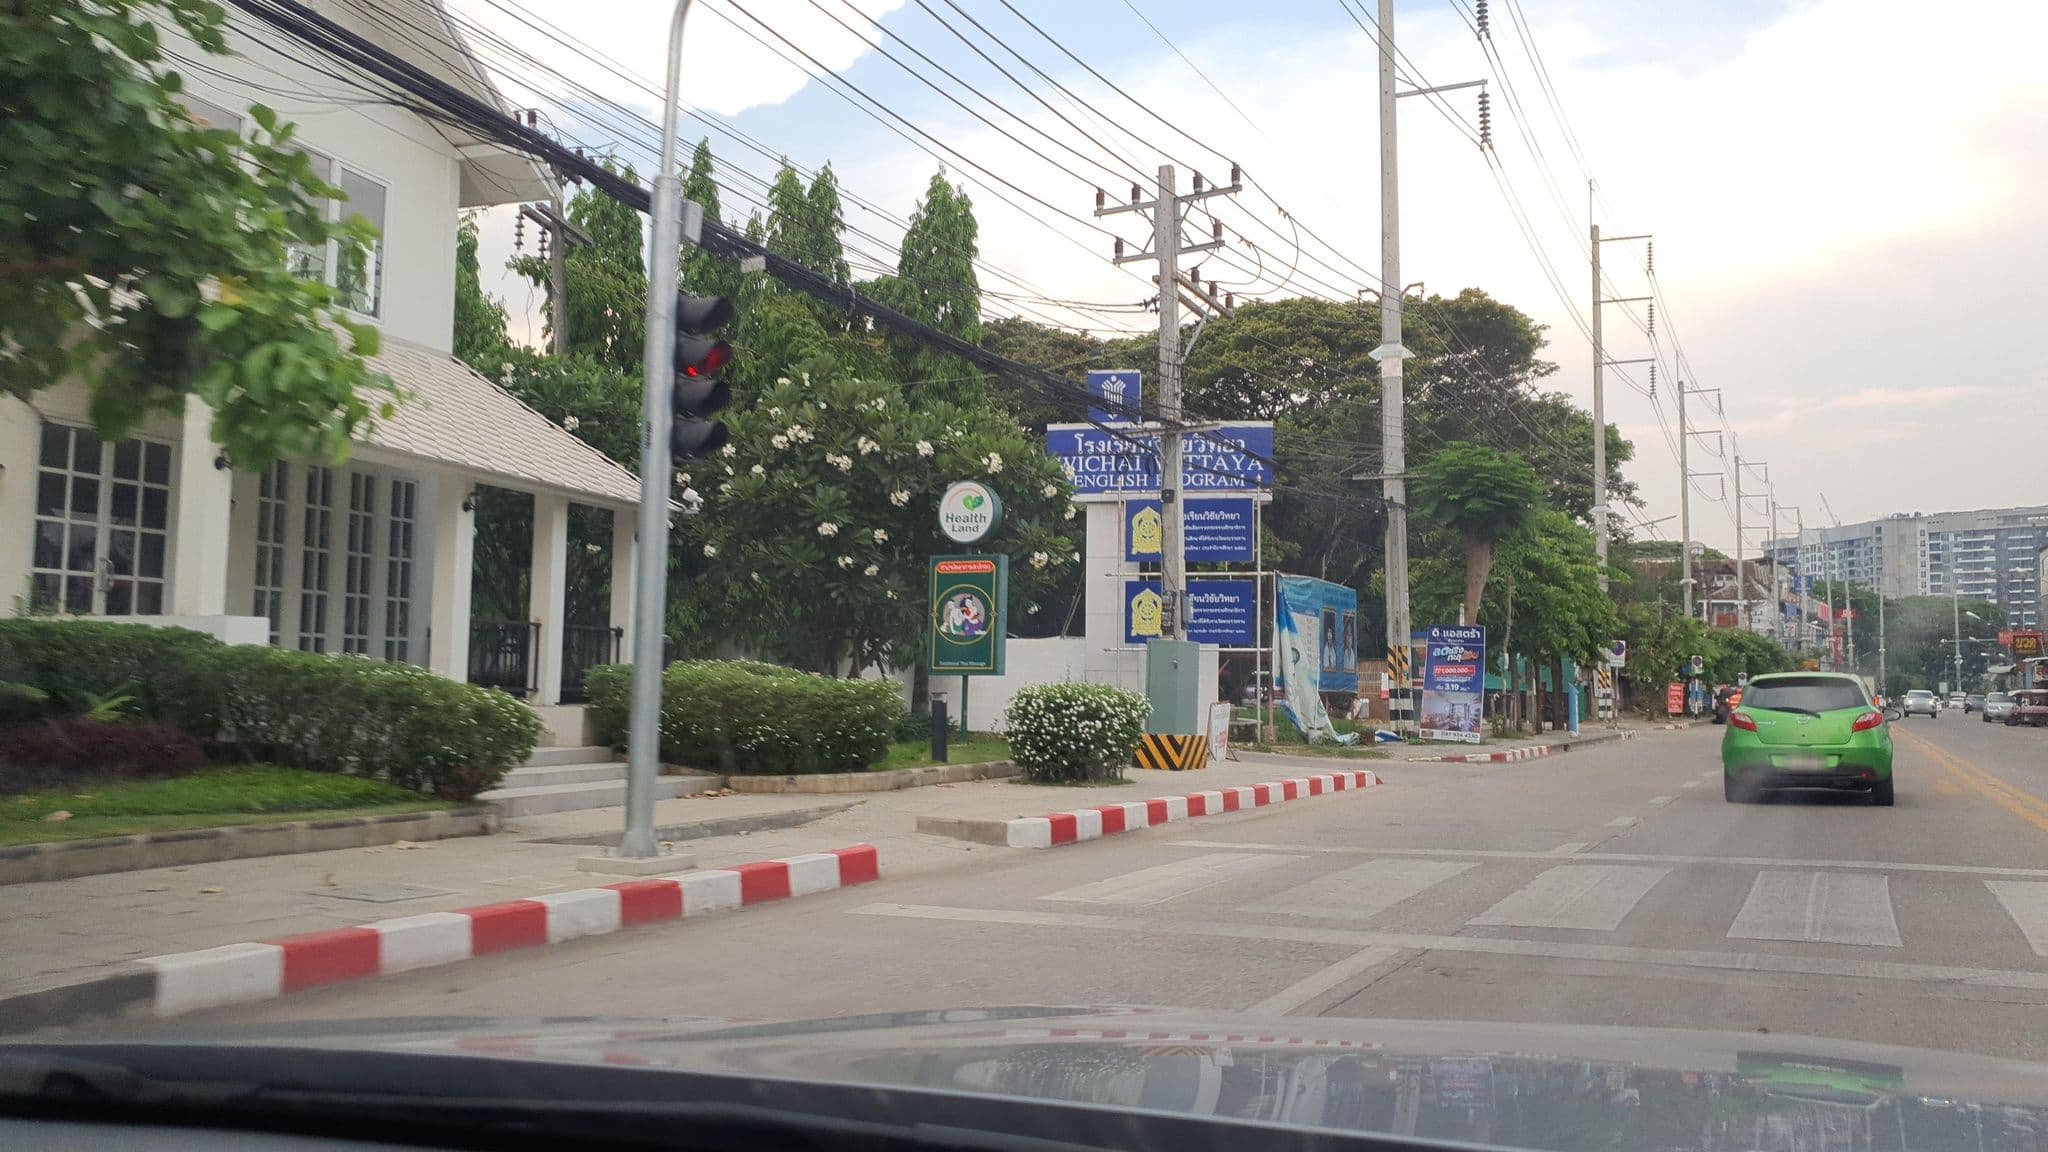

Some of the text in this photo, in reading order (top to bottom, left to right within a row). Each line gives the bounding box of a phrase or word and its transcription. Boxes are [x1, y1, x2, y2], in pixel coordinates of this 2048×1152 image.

[1074, 474, 1148, 488] ENGLISH
[945, 512, 986, 523] Health
[952, 524, 979, 533] Land
